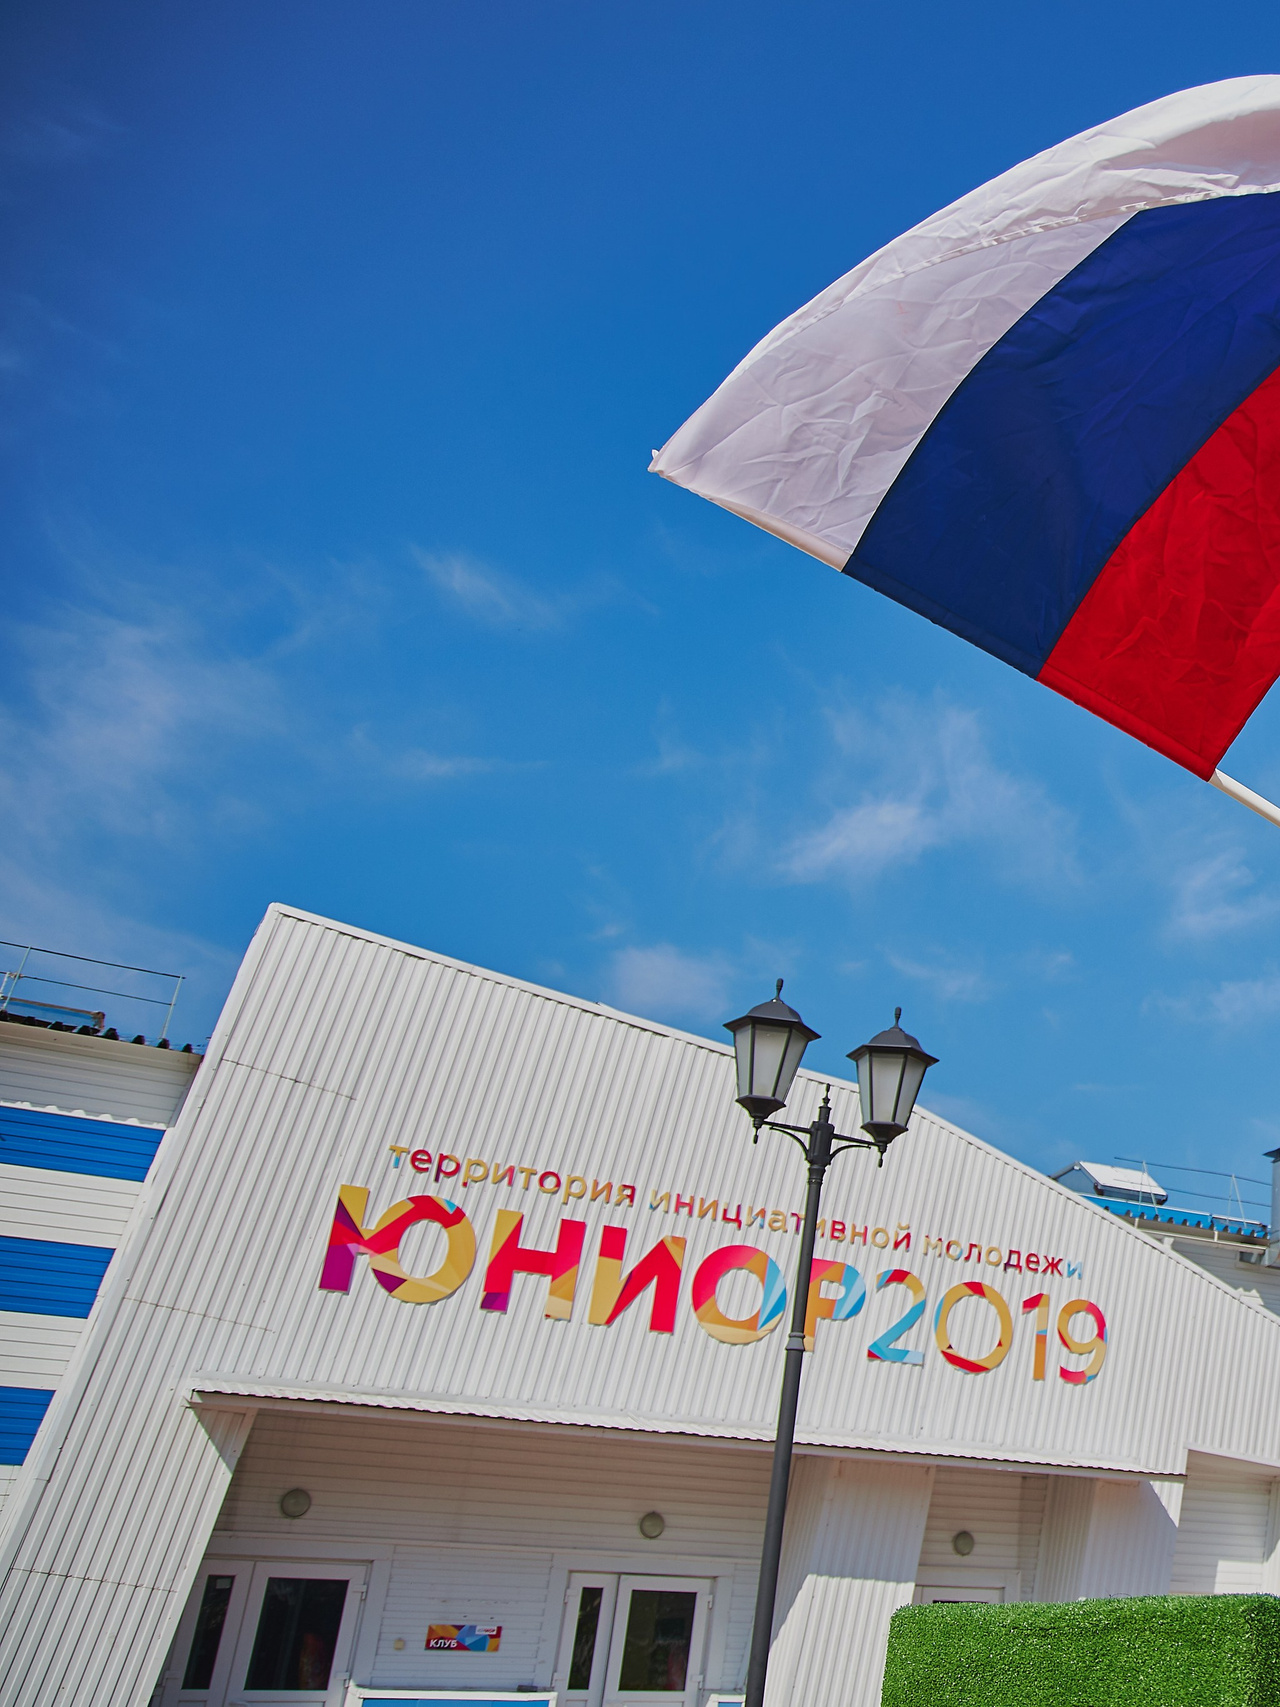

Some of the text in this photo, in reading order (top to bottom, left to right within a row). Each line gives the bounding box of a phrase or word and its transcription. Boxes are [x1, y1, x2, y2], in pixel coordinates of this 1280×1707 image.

[389, 1144, 636, 1206] территория
[922, 1234, 1084, 1280] молодежи
[429, 1639, 458, 1648] КЛУБ
